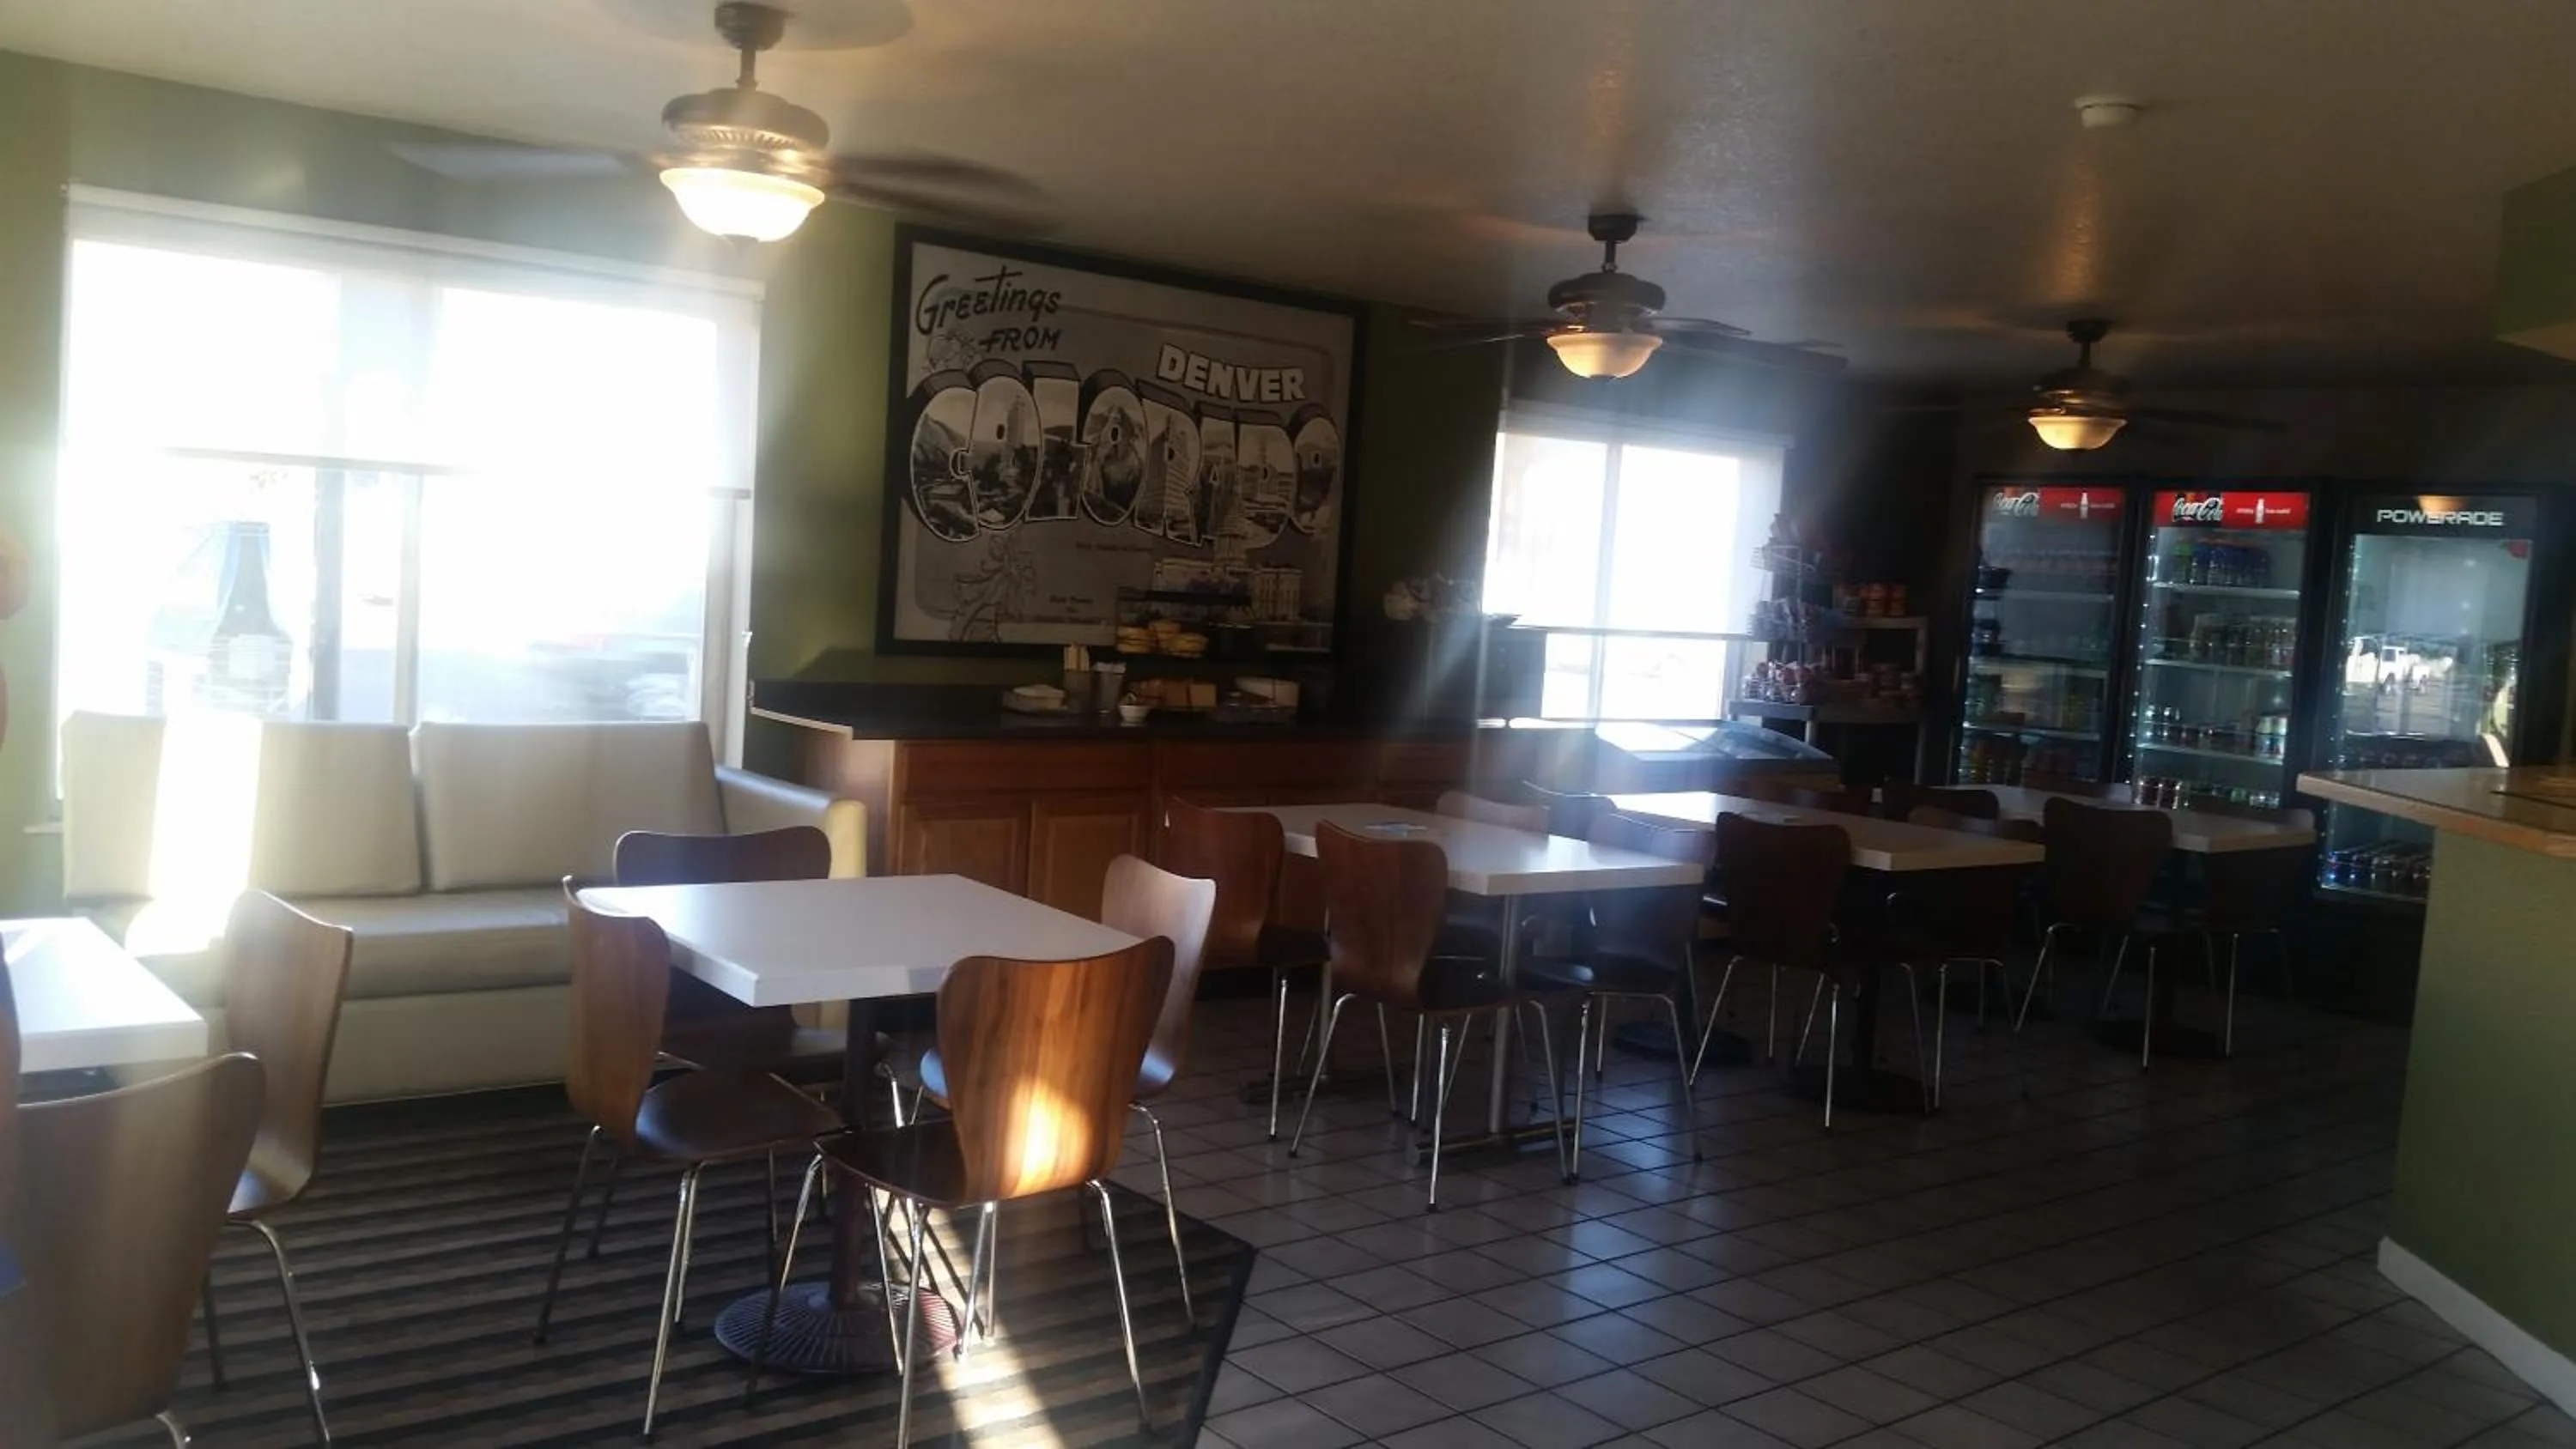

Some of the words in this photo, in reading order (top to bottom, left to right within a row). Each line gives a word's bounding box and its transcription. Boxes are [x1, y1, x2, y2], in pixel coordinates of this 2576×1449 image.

[915, 265, 1061, 336] Greetings
[978, 325, 1061, 353] FROM
[1157, 343, 1305, 403] DENVER
[908, 359, 1341, 549] COLORADO
[2377, 509, 2505, 526] POWERADE
